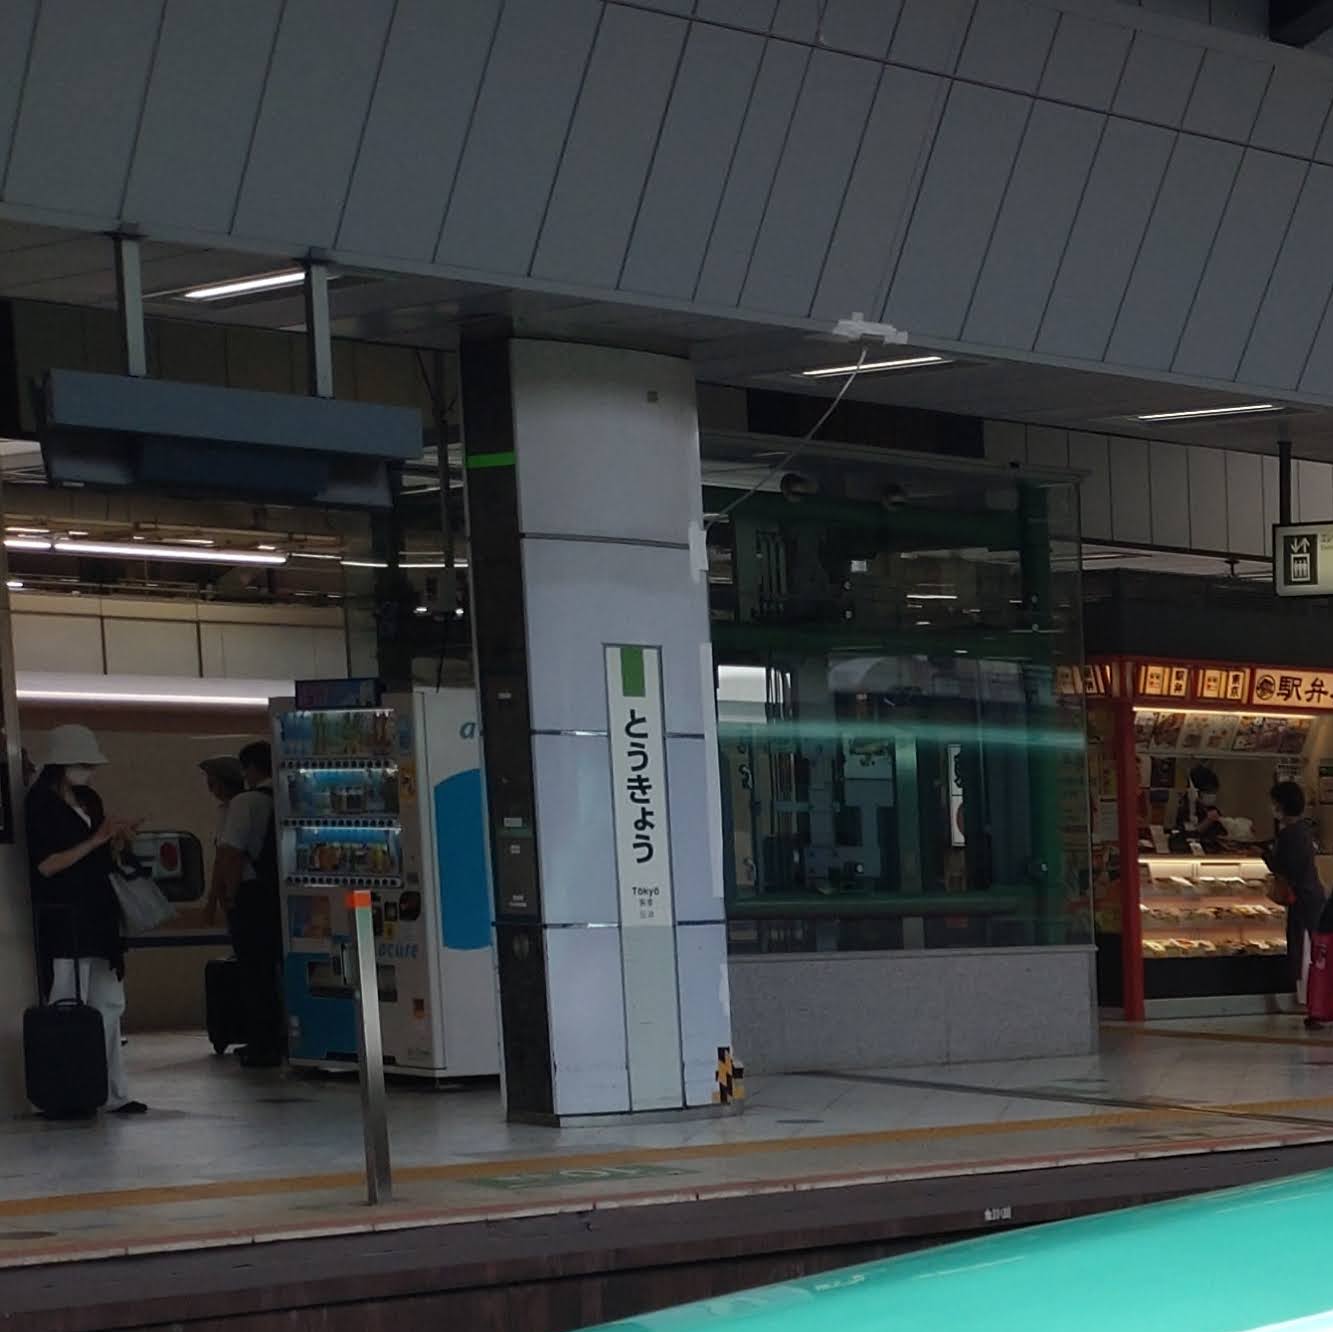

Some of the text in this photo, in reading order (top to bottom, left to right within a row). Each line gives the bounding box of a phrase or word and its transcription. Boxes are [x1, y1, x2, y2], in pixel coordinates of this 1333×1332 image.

[625, 708, 656, 864] とうきょう
